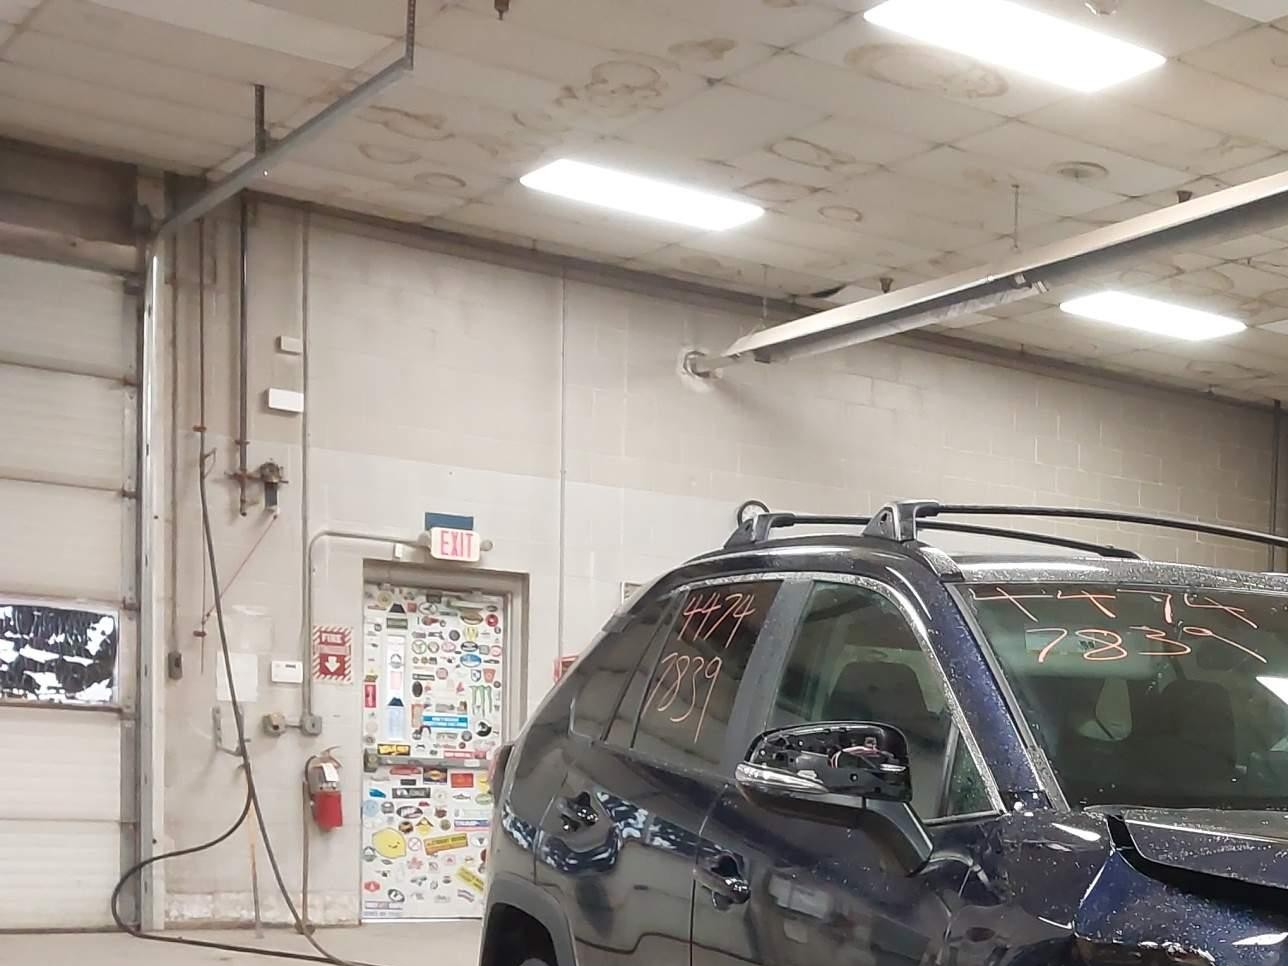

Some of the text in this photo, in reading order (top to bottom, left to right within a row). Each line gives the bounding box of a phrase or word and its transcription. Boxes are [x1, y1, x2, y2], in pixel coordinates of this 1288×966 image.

[440, 530, 474, 559] EXIT
[677, 591, 756, 649] 4474
[1025, 625, 1268, 664] 7839
[640, 652, 723, 744] 7839
